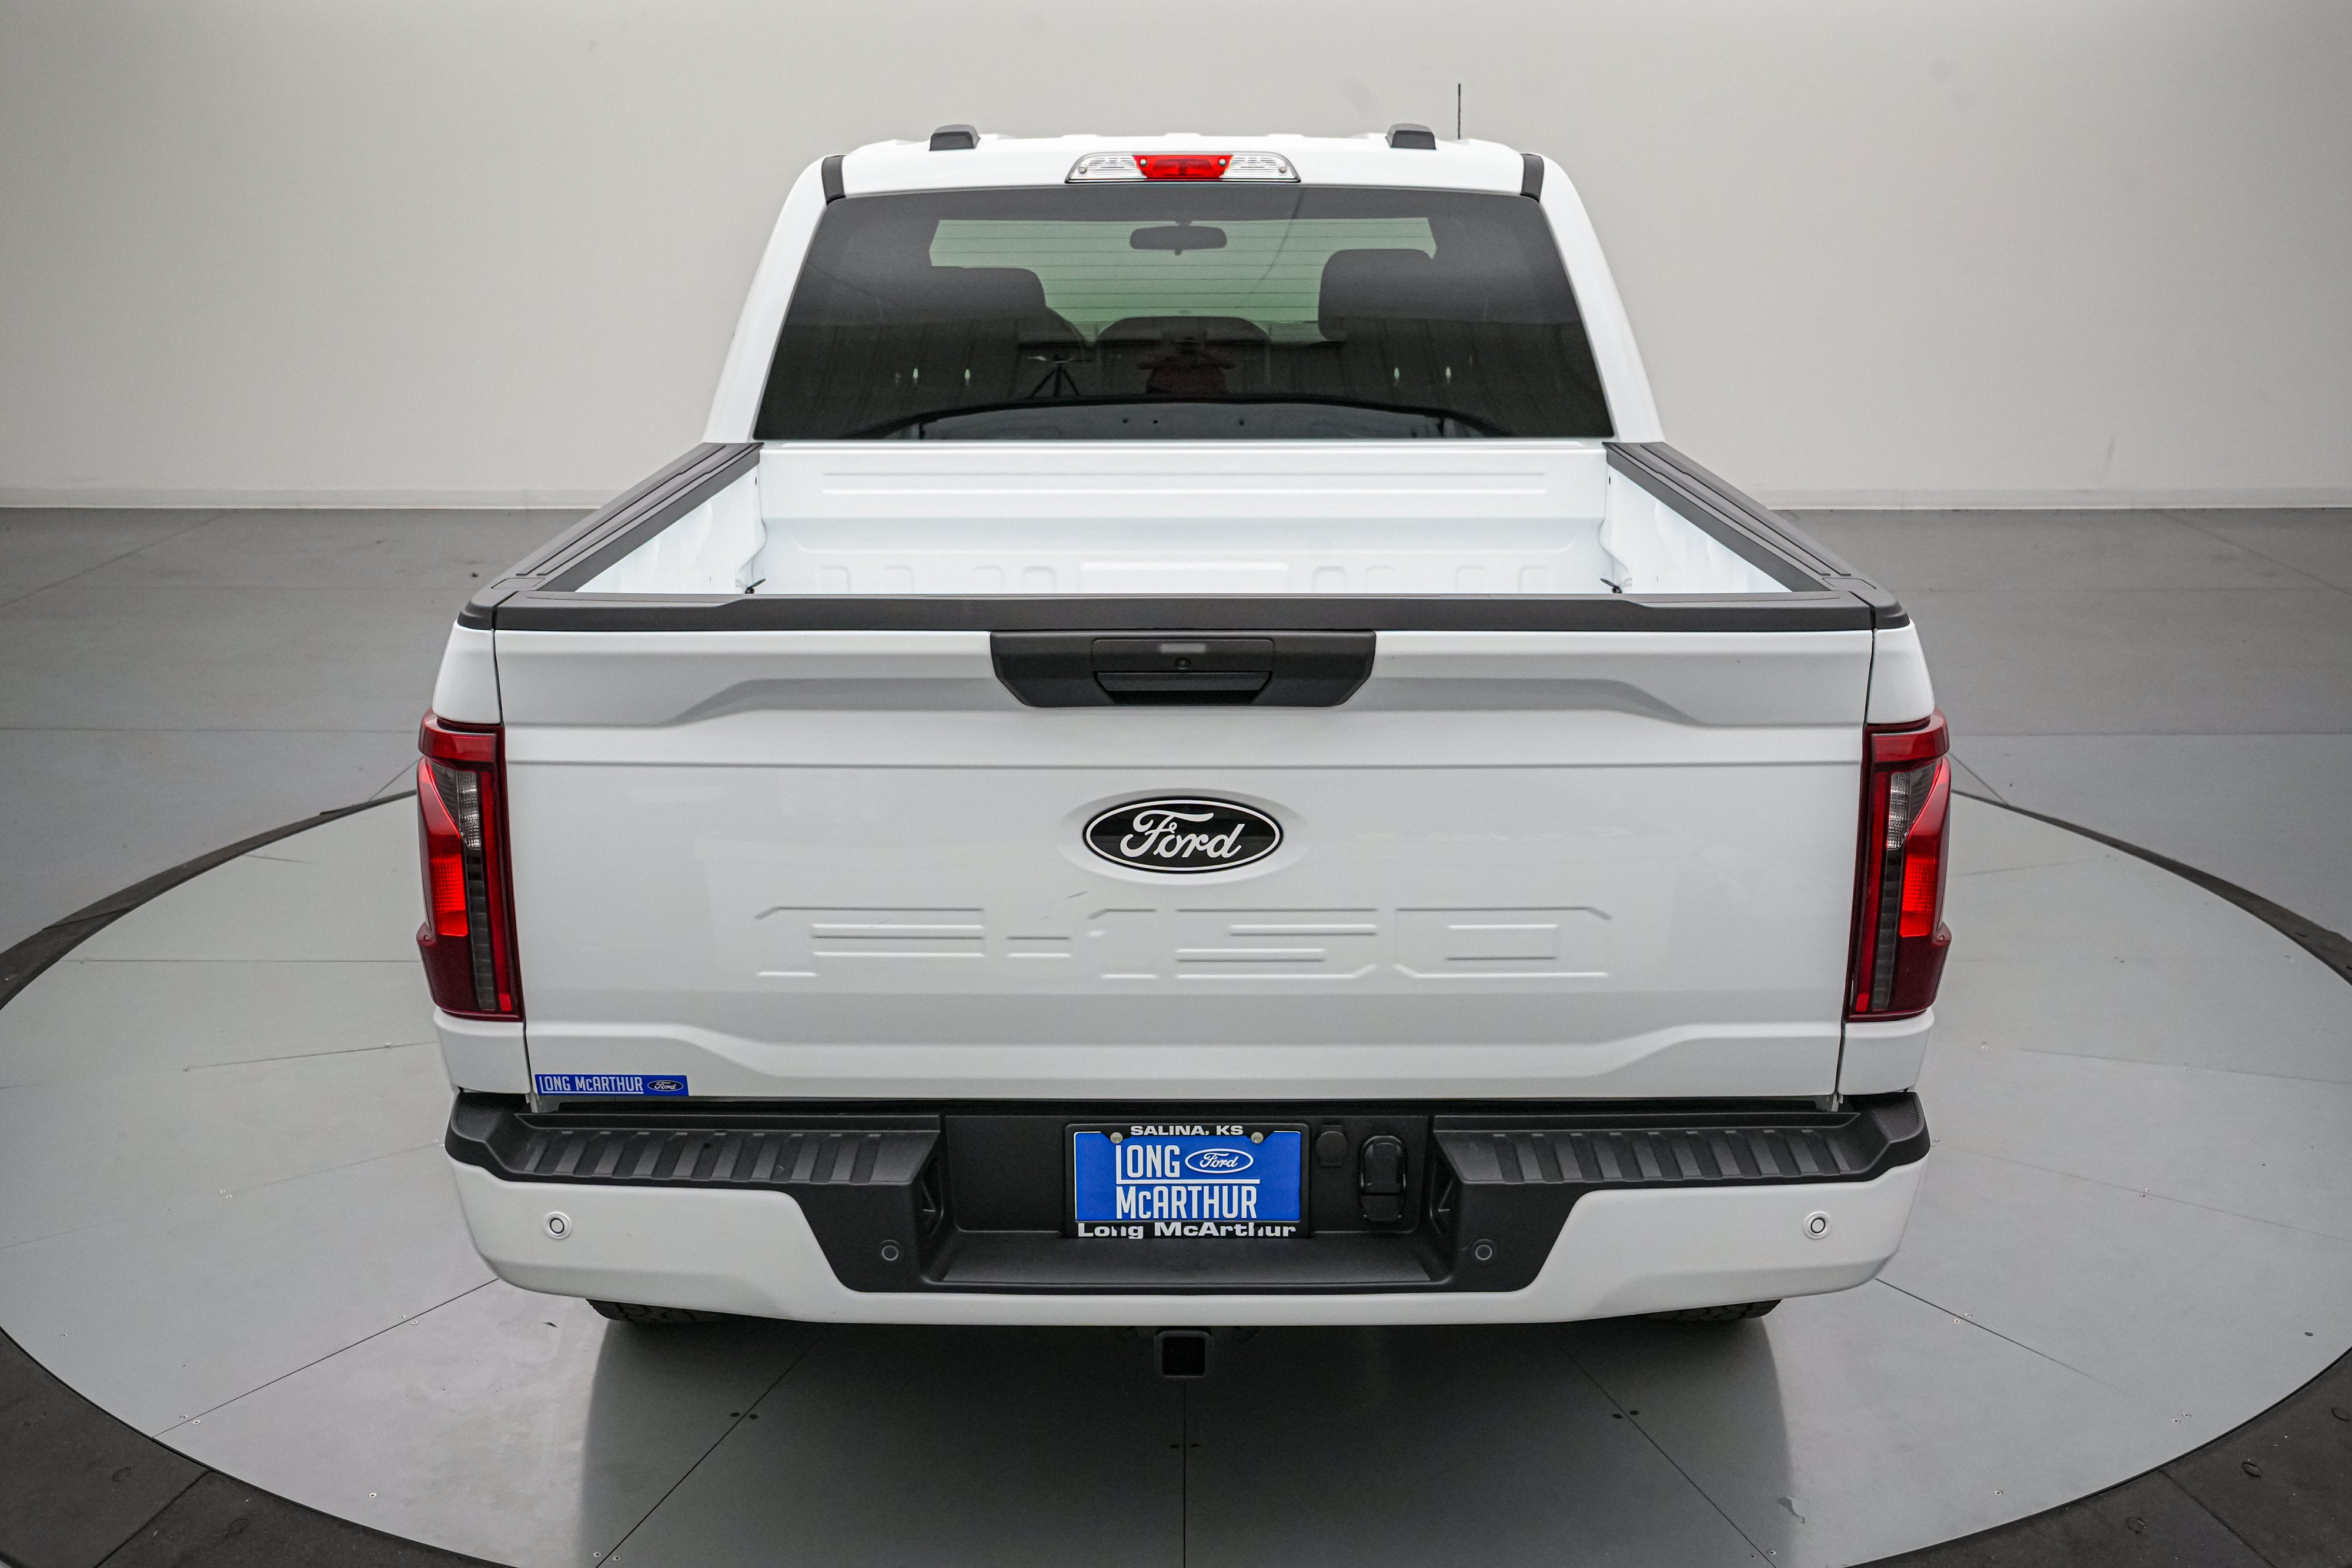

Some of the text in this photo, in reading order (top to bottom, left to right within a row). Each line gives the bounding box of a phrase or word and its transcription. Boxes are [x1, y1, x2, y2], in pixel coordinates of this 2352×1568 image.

[1120, 810, 1246, 858] Ford
[754, 906, 1611, 979] F-150
[539, 1076, 570, 1092] LONG
[576, 1076, 643, 1092] McARTHUR
[1130, 1125, 1243, 1136] SALINA, KS
[1115, 1145, 1238, 1183] LONG Ford
[1116, 1186, 1257, 1219] McARTHUR
[1078, 1222, 1296, 1239] Long McArthur
